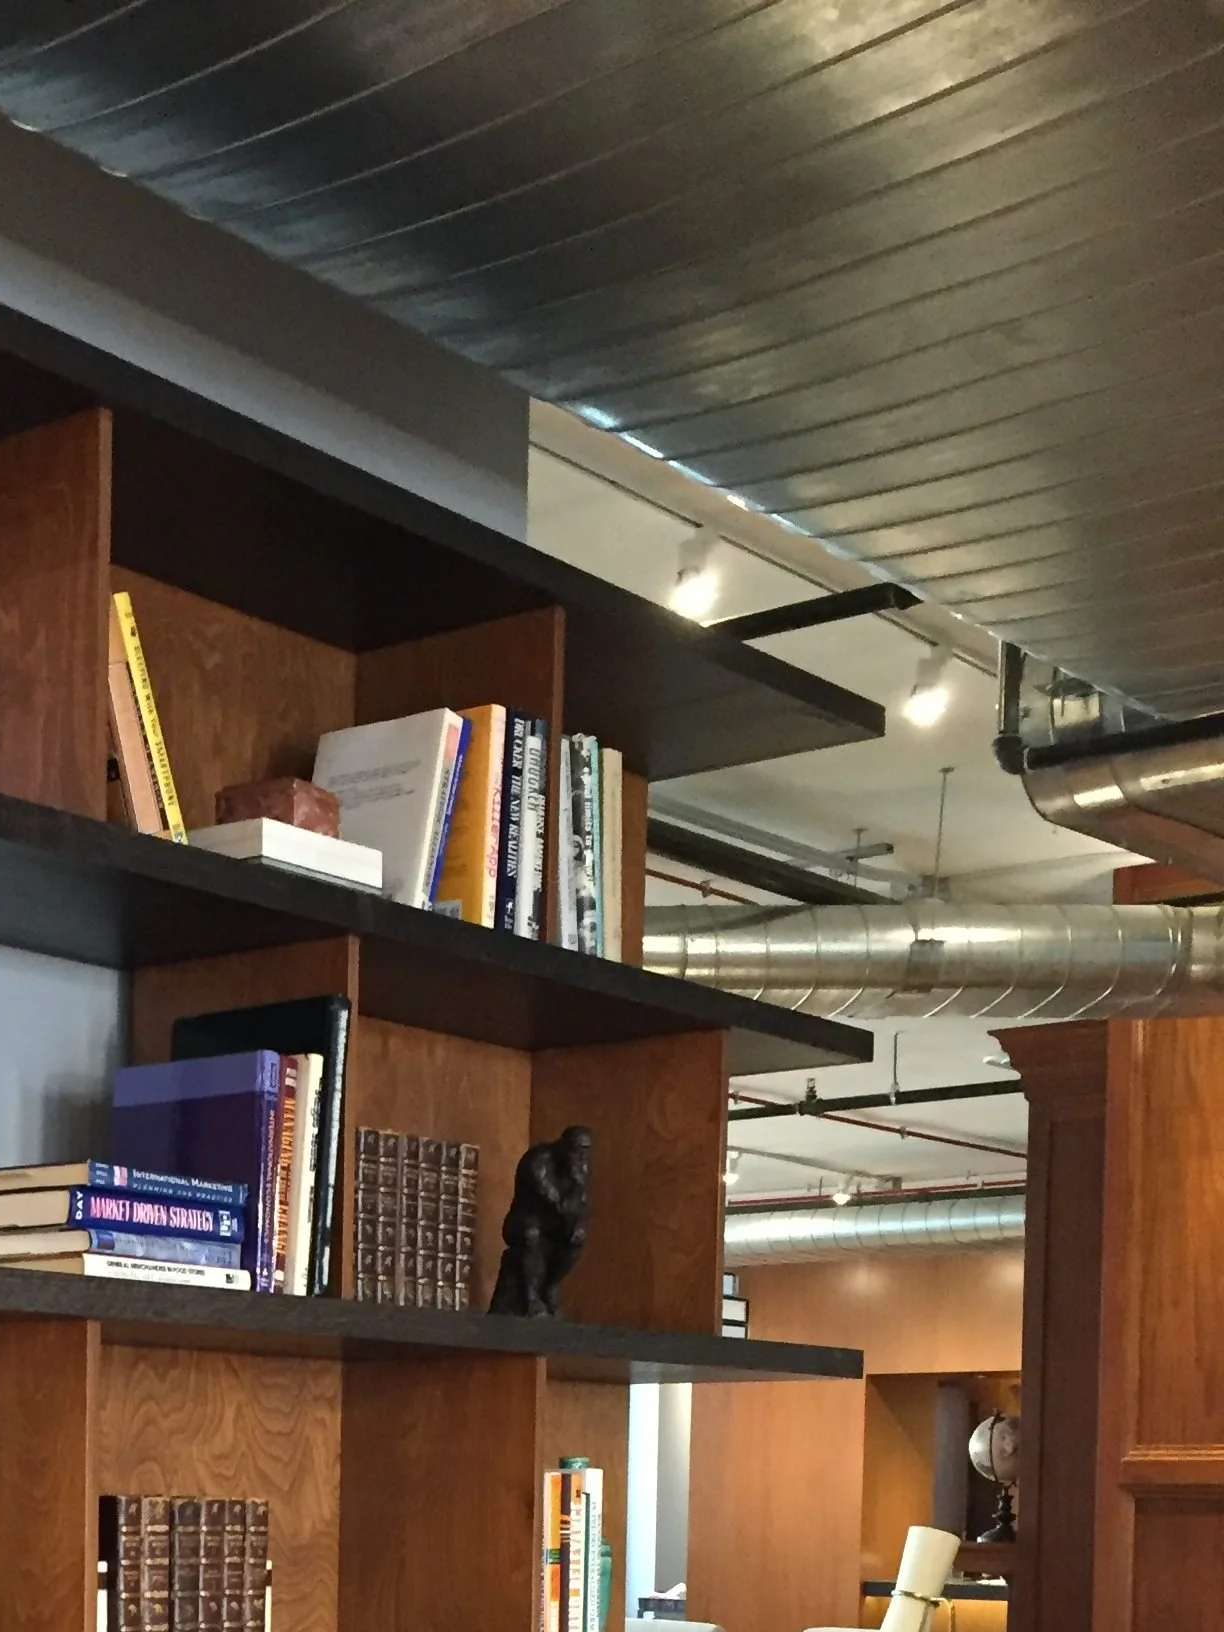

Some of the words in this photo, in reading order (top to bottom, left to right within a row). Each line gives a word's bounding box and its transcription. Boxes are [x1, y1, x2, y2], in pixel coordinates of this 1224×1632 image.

[510, 775, 521, 799] THE
[510, 799, 521, 822] NEW
[507, 824, 519, 878] REALITIES
[279, 1097, 296, 1167] MANAGING
[75, 1191, 83, 1220] DAY
[90, 1197, 130, 1222] MARKET
[133, 1202, 167, 1226] DRIVEN
[169, 1207, 214, 1232] STRATEGY
